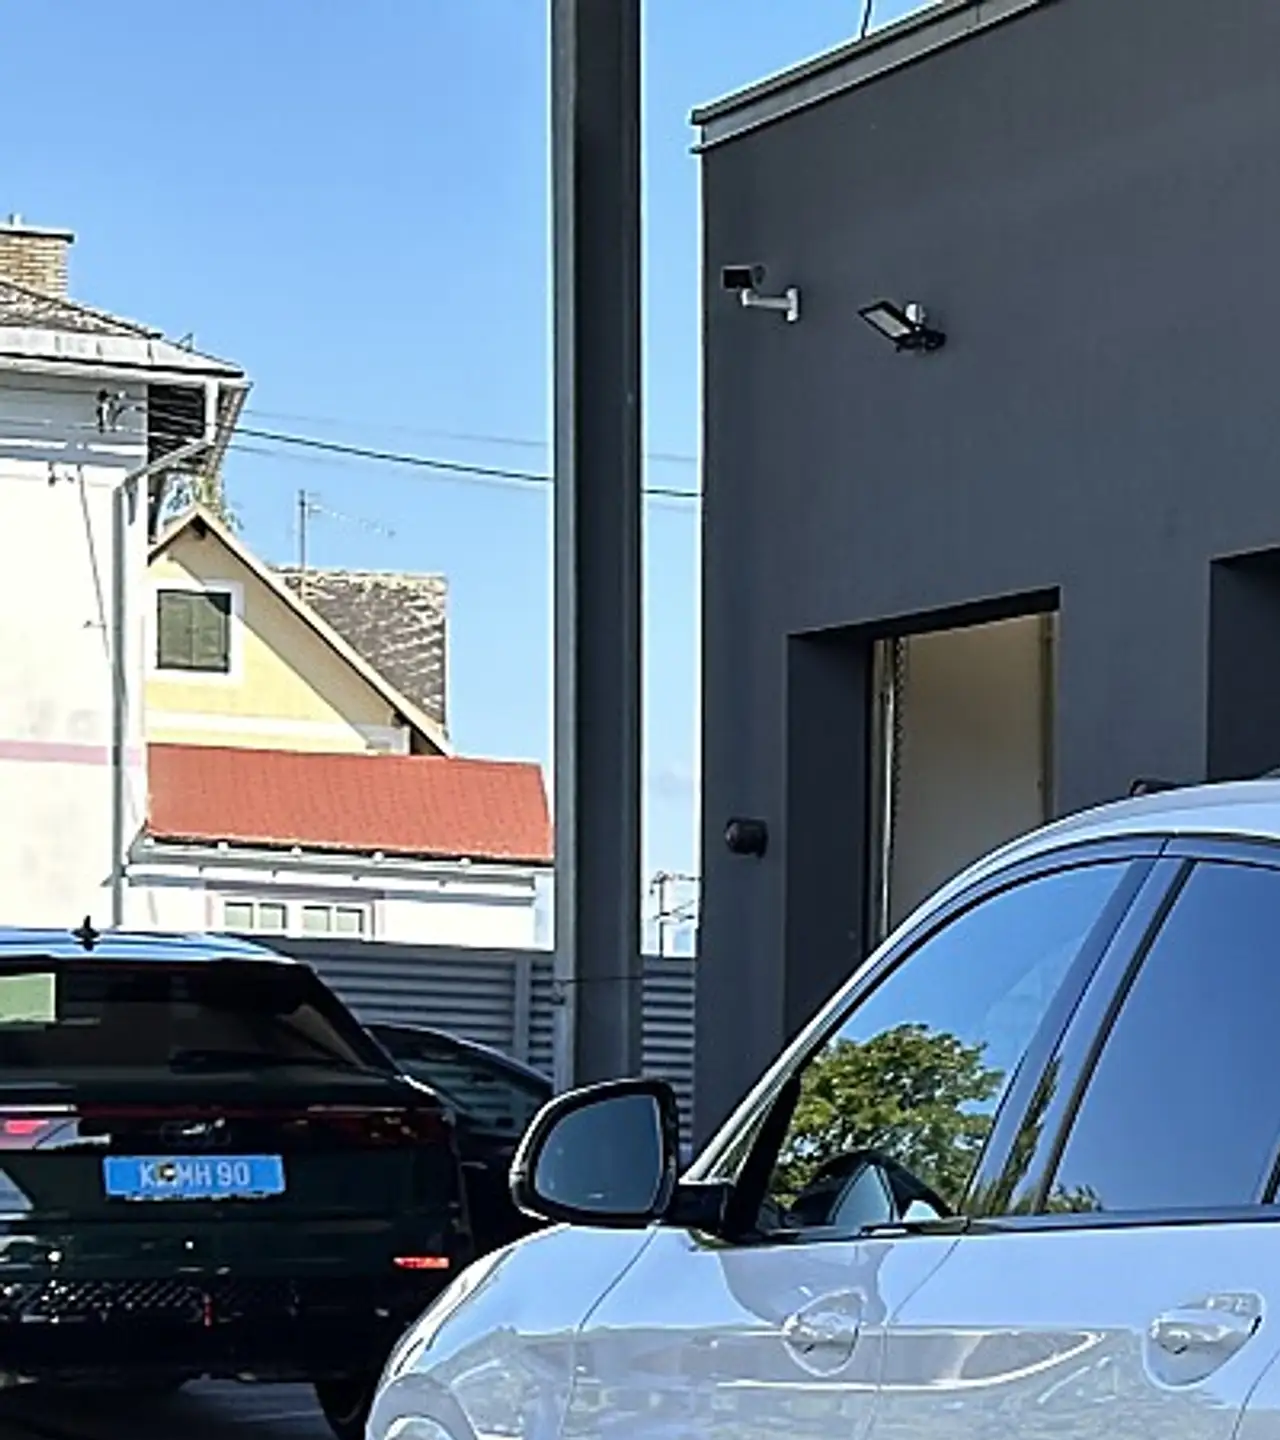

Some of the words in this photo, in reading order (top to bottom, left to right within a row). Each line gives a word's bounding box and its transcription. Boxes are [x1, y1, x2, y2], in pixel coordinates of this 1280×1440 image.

[138, 1160, 156, 1189] K
[176, 1160, 212, 1188] MH
[217, 1160, 250, 1187] 90
